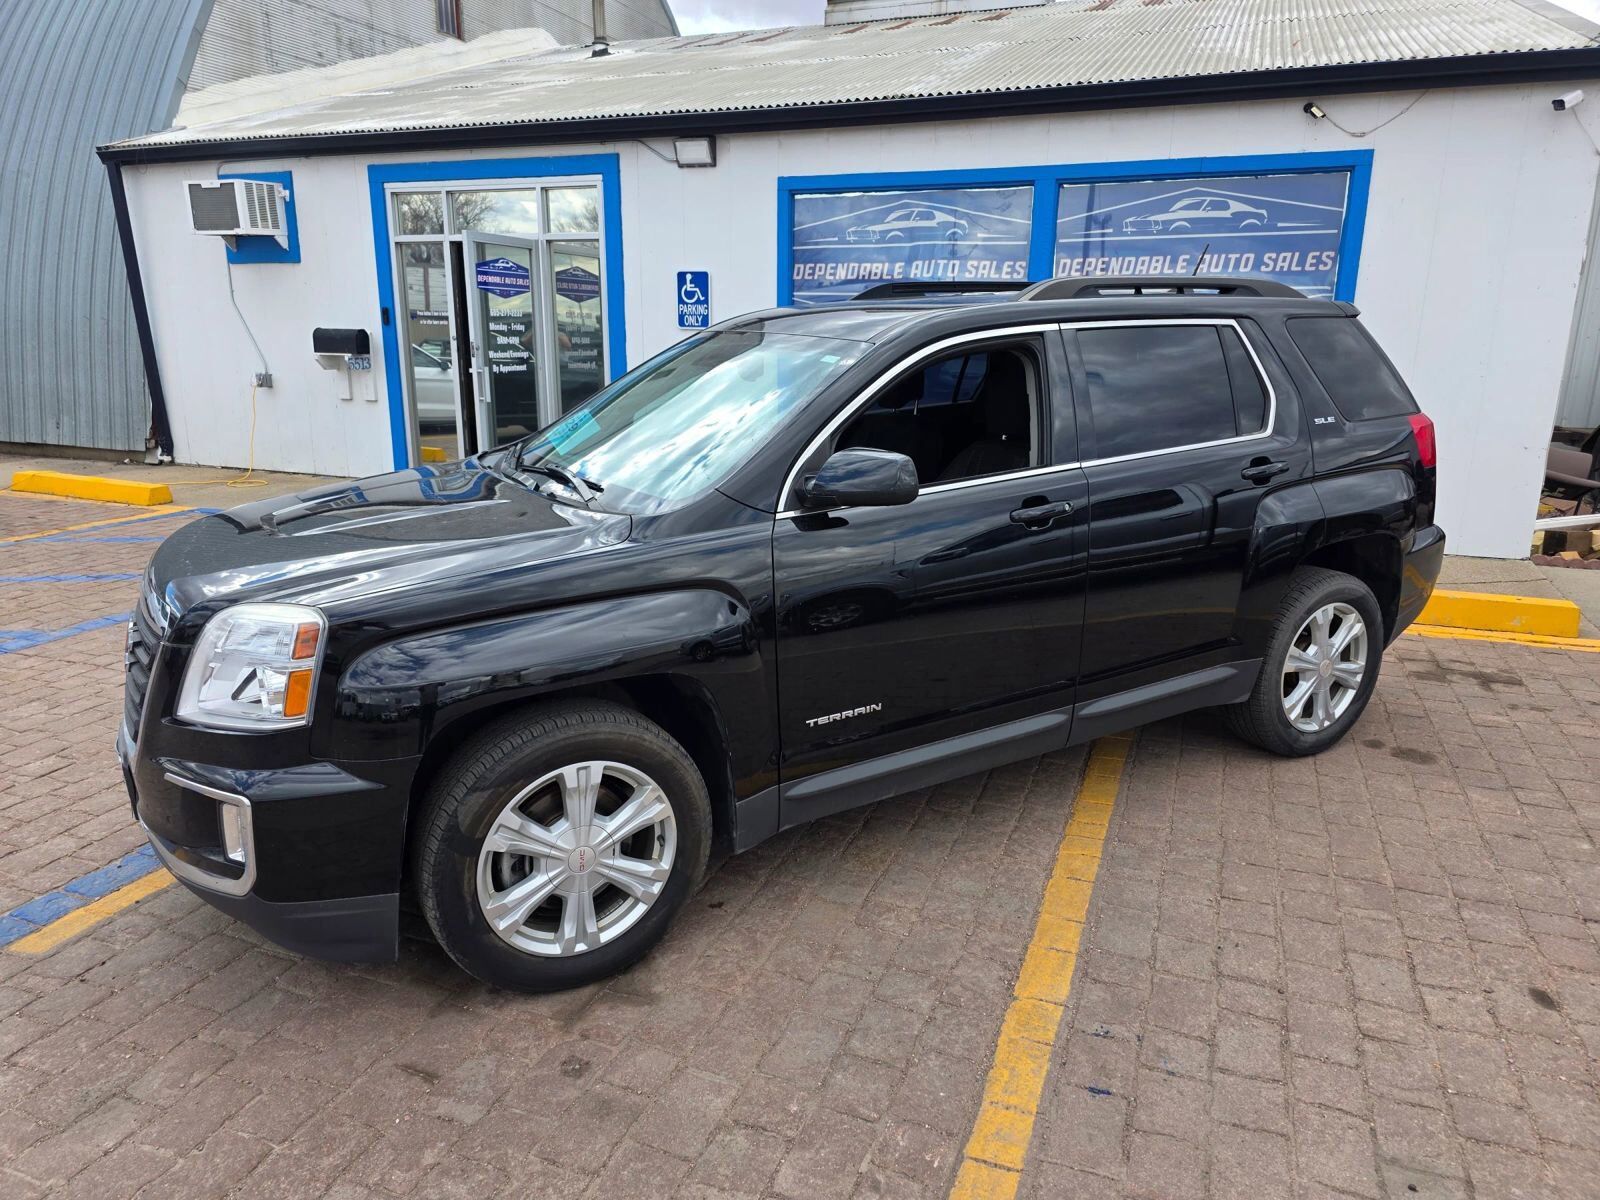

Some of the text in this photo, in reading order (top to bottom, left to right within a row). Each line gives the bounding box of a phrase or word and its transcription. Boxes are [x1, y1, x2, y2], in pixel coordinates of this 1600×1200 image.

[793, 259, 1027, 280] DEPENDABLE AUTO SALES
[1057, 251, 1336, 277] DEPENDABLE AUTO SALES
[478, 275, 529, 286] DEPENDABLE AUTO SALES
[679, 304, 708, 315] PARKING
[684, 315, 703, 326] ONLY
[489, 322, 508, 333] Monday
[511, 322, 525, 333] Friday
[348, 357, 372, 370] 5513
[492, 364, 528, 374] By Appointment
[1314, 416, 1336, 425] SLE
[805, 702, 882, 728] TERRAIN
